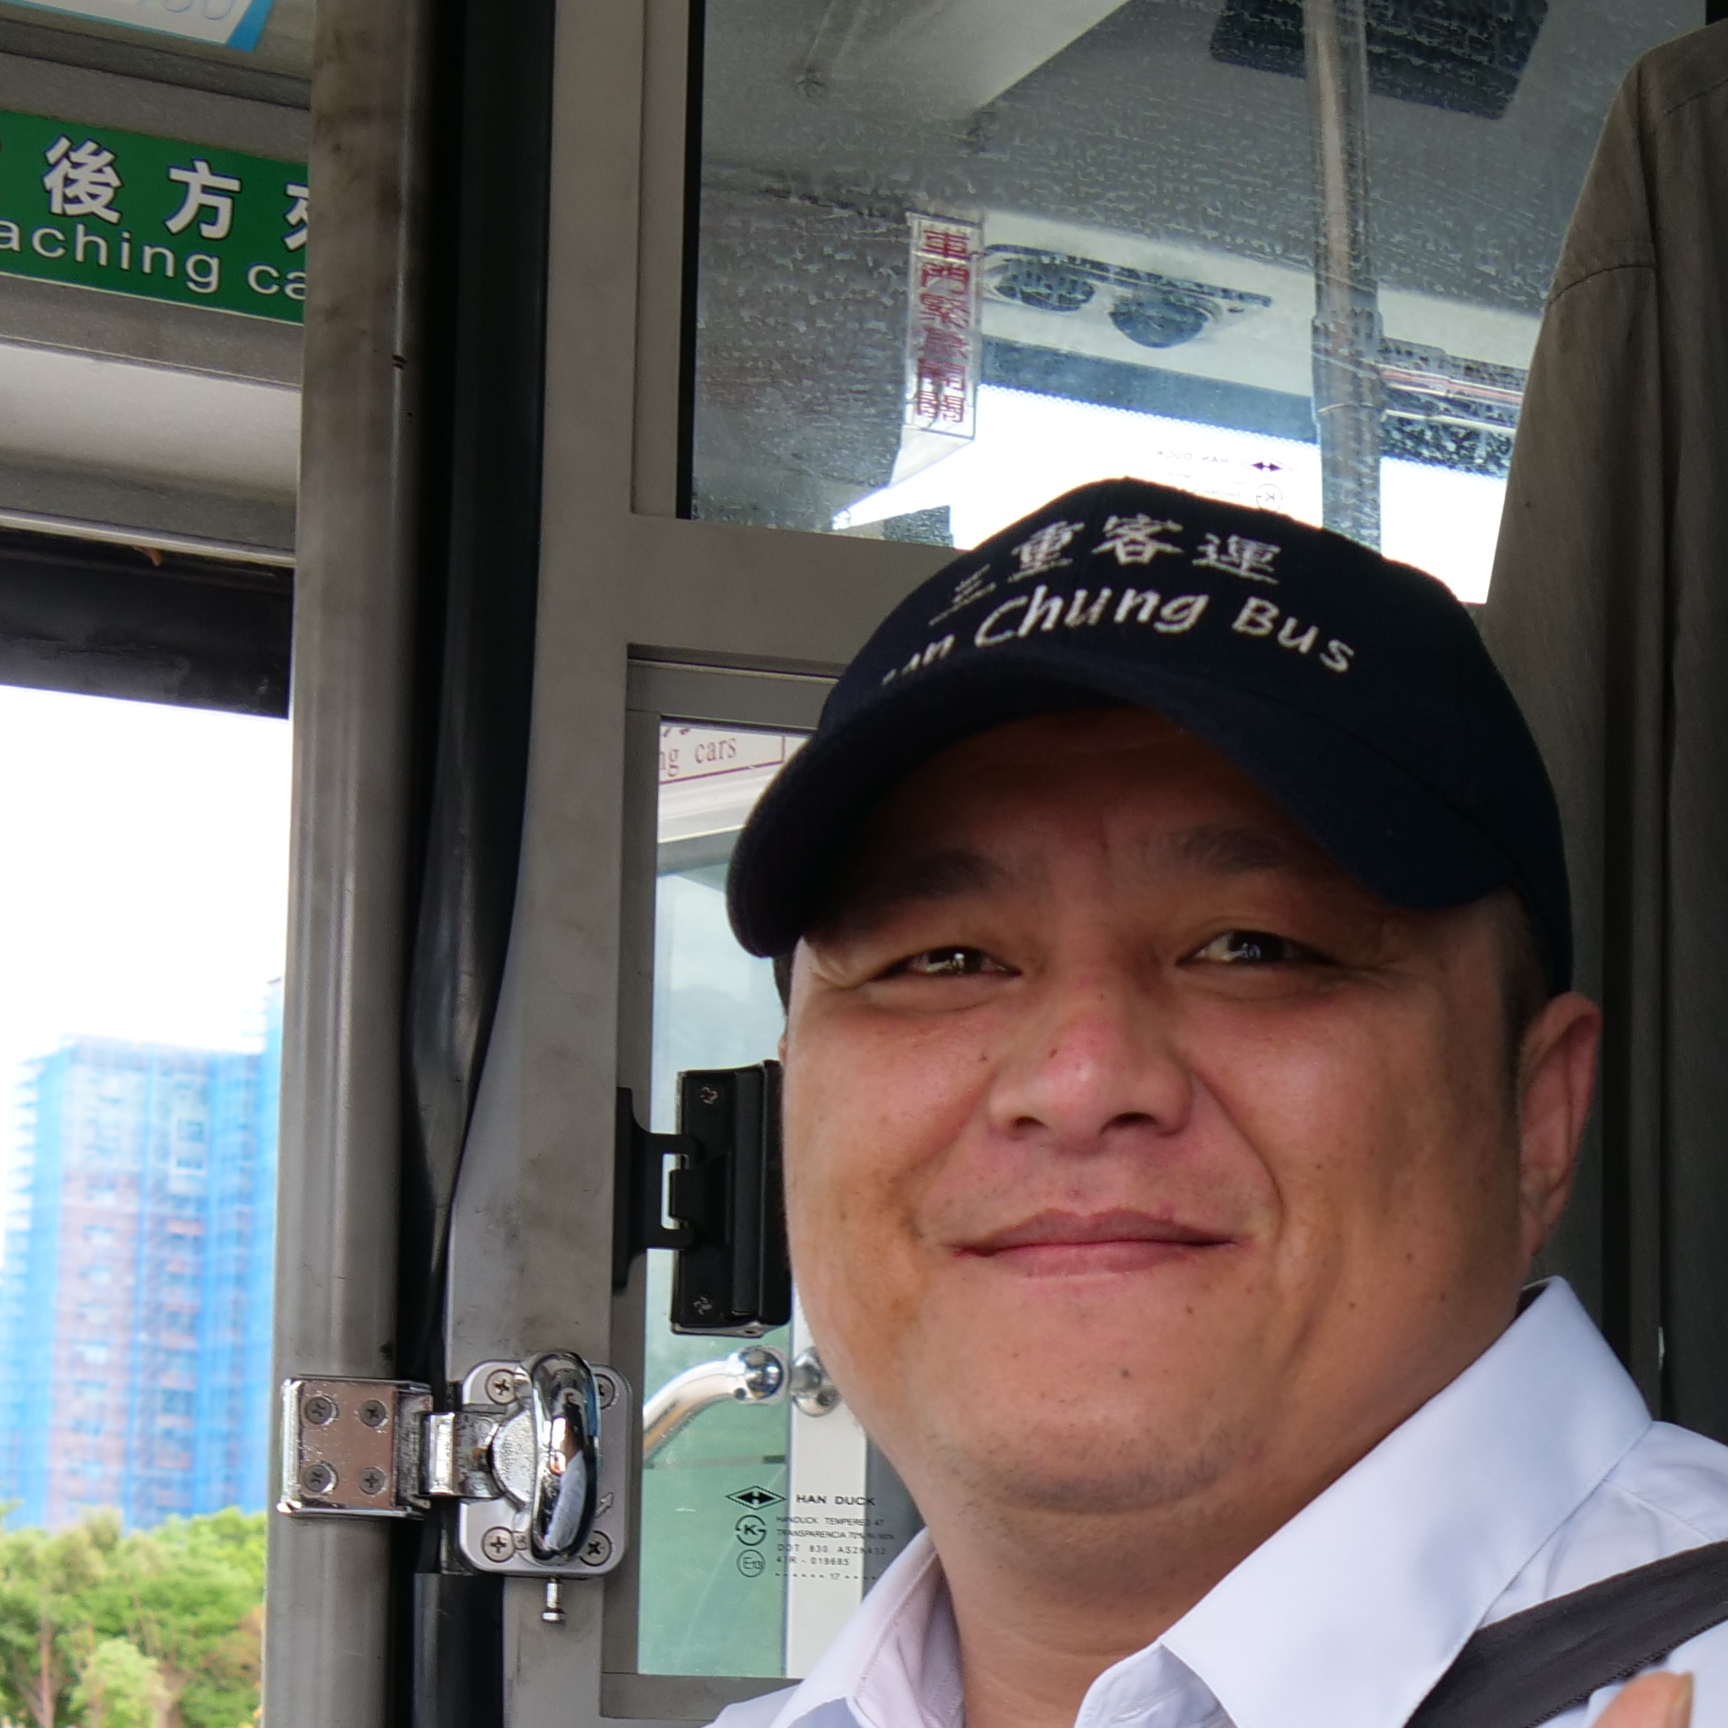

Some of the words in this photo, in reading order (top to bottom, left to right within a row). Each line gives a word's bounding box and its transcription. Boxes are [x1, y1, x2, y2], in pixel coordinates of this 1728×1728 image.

[928, 513, 1281, 627] 三重客運
[974, 585, 1209, 648] Chung
[1232, 596, 1355, 673] Bus
[694, 738, 737, 763] cars
[796, 1494, 827, 1504] HAN
[835, 1496, 875, 1506] DUCK
[777, 1543, 800, 1552] DOT
